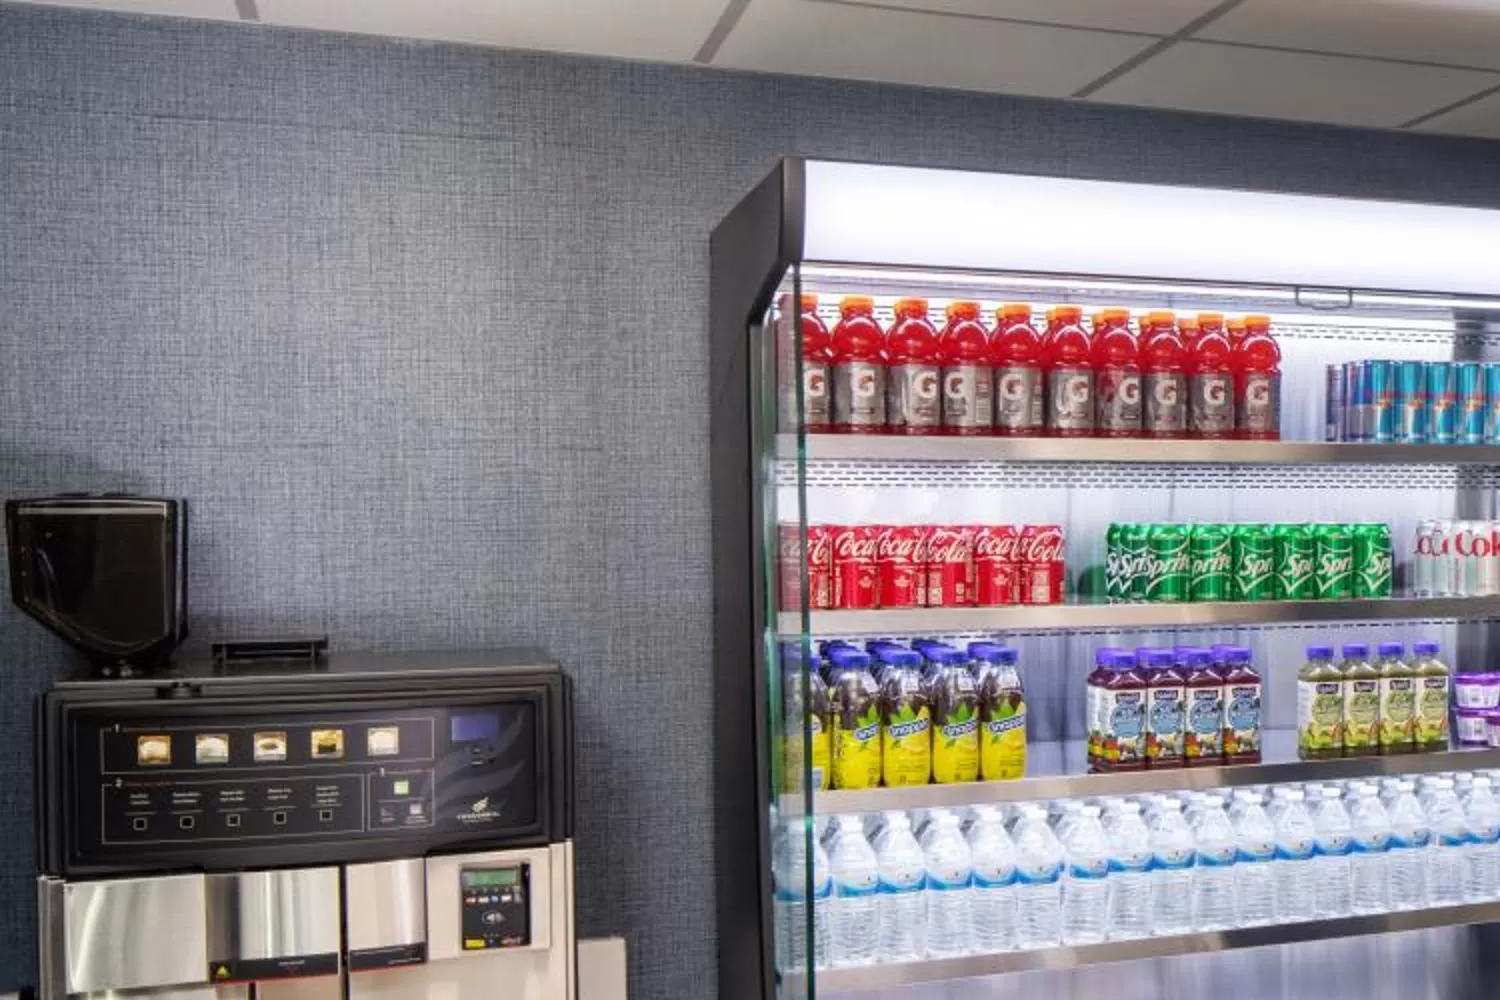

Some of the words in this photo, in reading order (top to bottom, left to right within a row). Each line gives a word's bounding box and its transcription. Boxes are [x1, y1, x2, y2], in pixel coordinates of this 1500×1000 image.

[804, 370, 825, 397] G
[854, 369, 875, 396] G
[914, 371, 937, 398] G
[945, 372, 964, 398] G
[1001, 373, 1024, 399] G
[1065, 376, 1089, 402] G
[1119, 377, 1140, 404] G
[1155, 379, 1177, 405] G
[1204, 379, 1225, 405] G
[1247, 379, 1268, 405] G
